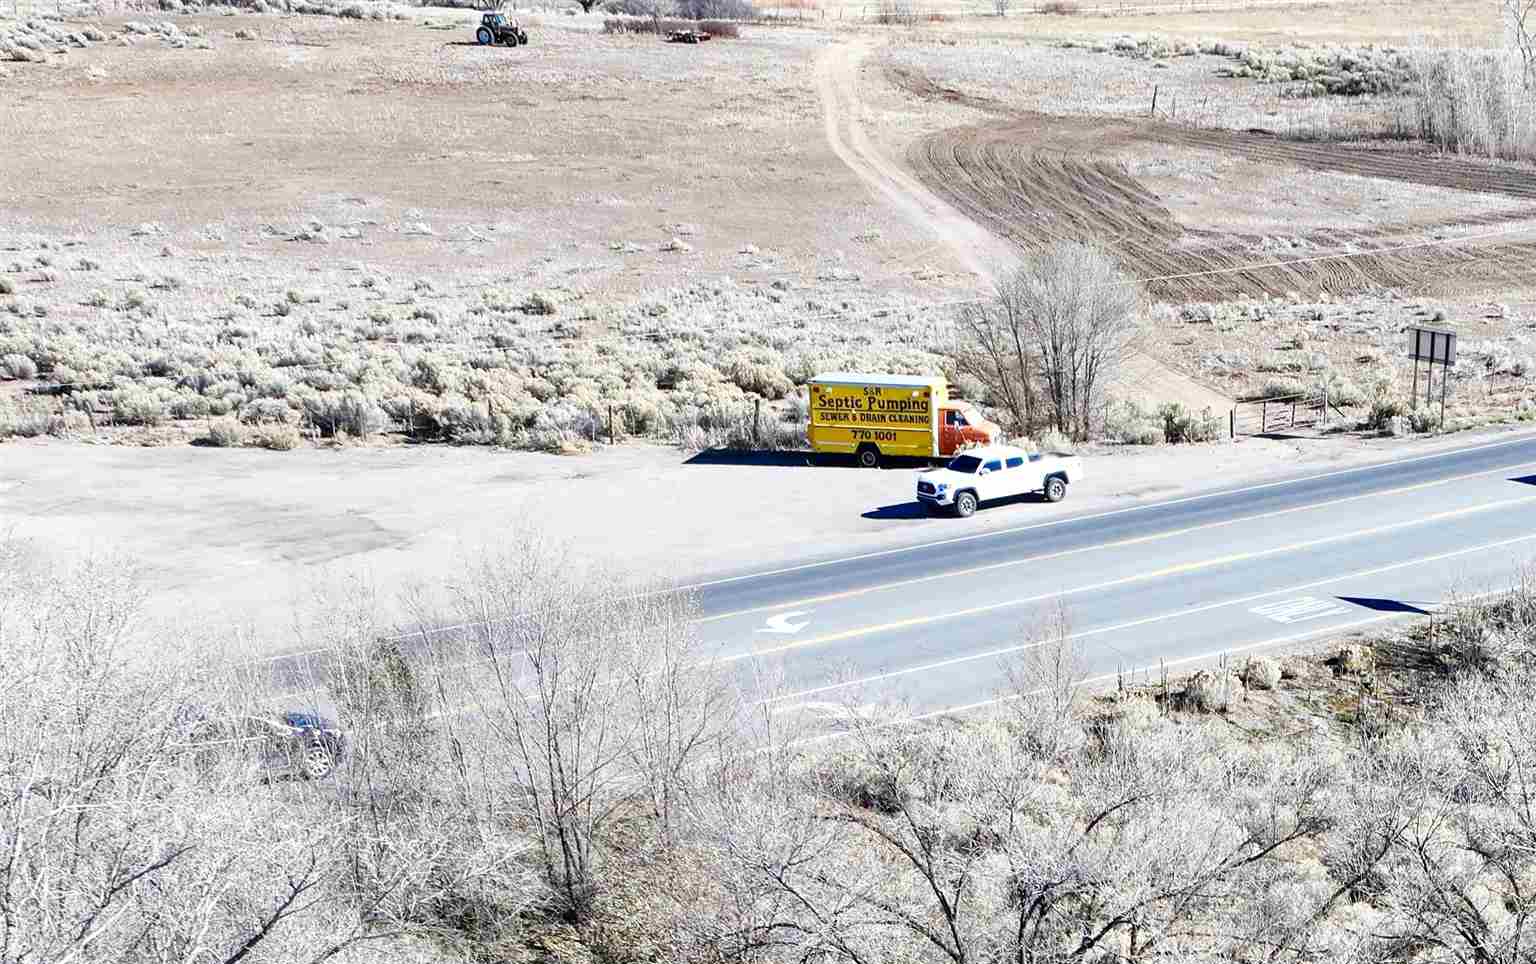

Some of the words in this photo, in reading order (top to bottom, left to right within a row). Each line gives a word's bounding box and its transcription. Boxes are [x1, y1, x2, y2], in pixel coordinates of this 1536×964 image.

[818, 394, 863, 409] Septic
[868, 396, 929, 412] Pumping
[820, 411, 849, 421] SEWER
[860, 413, 887, 423] DRAIN
[889, 414, 929, 424] CLEANING
[851, 429, 872, 440] 770
[875, 431, 897, 441] 1001
